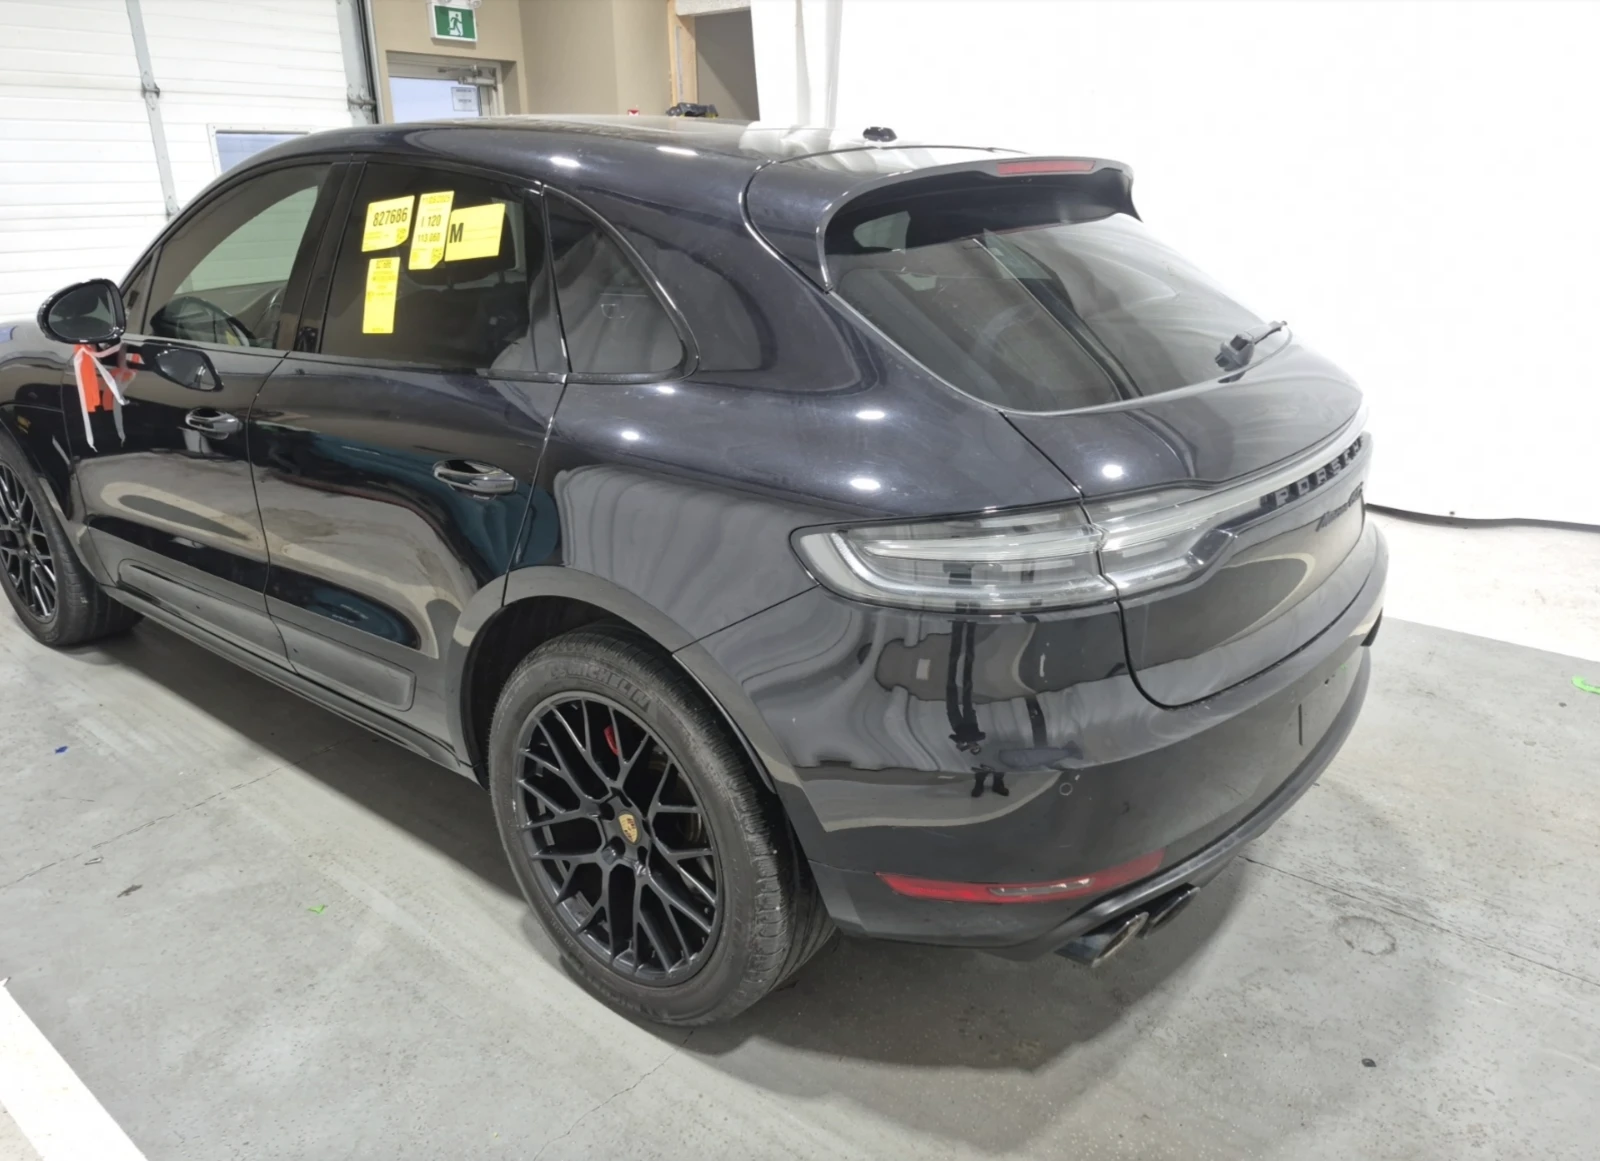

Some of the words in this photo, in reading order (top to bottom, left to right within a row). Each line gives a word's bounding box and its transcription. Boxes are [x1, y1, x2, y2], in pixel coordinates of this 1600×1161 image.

[372, 207, 409, 227] 827686
[427, 214, 442, 227] 120
[449, 222, 464, 244] M
[567, 661, 653, 713] MICHELIN
